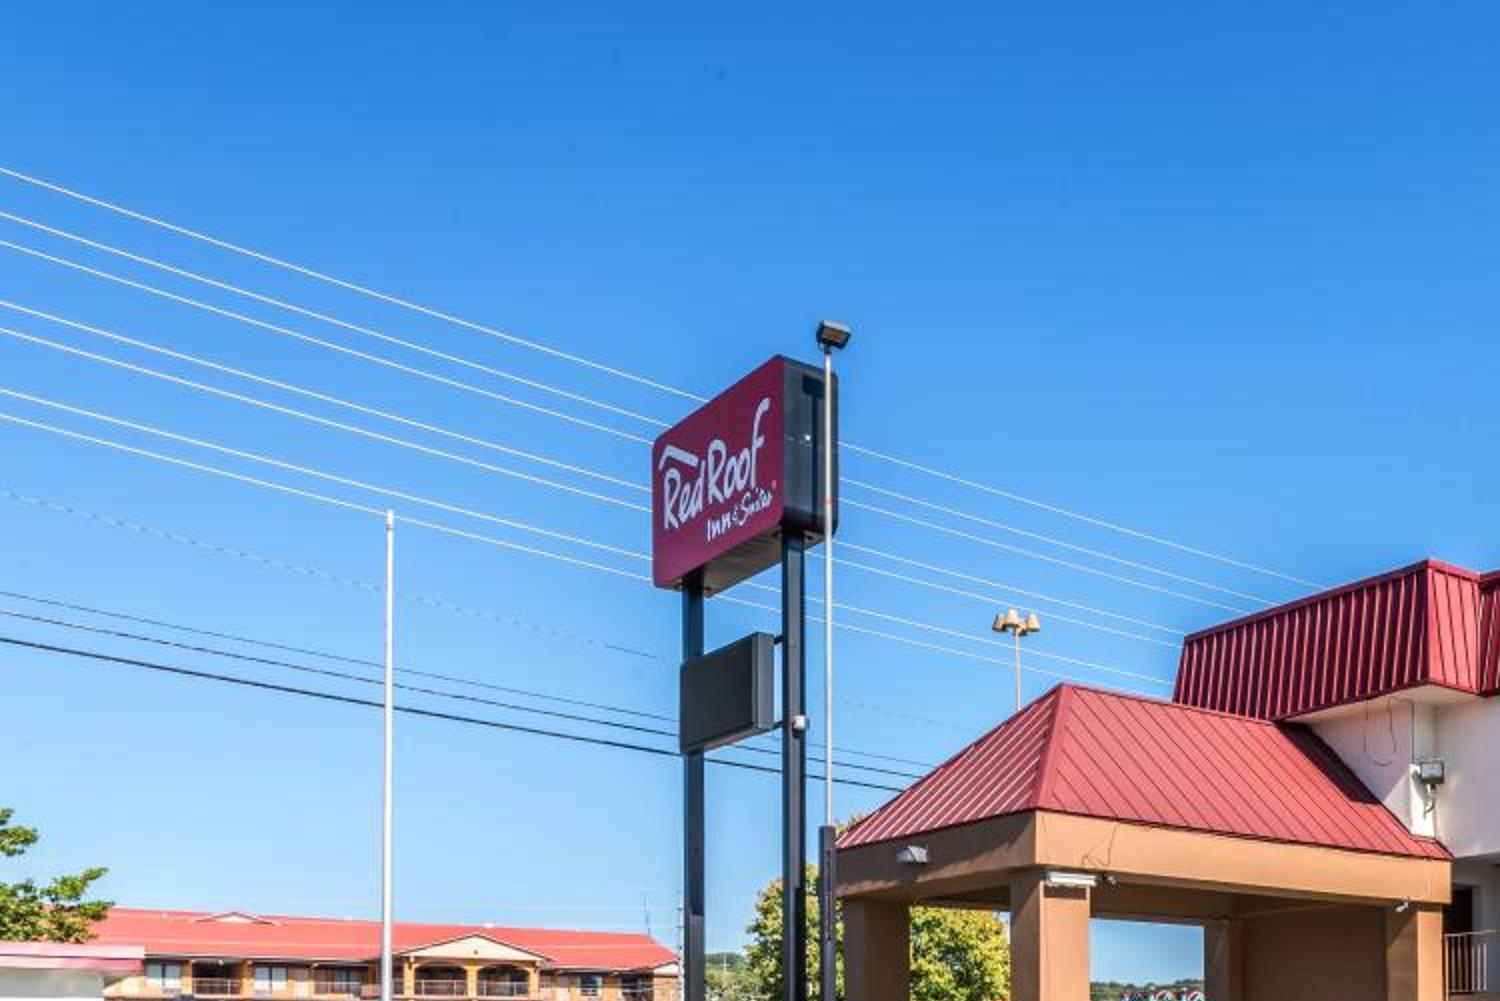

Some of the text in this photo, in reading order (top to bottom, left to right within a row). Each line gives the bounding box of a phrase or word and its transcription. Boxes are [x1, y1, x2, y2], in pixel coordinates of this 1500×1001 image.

[664, 397, 770, 529] Red Roof
[706, 512, 732, 541] Inn
